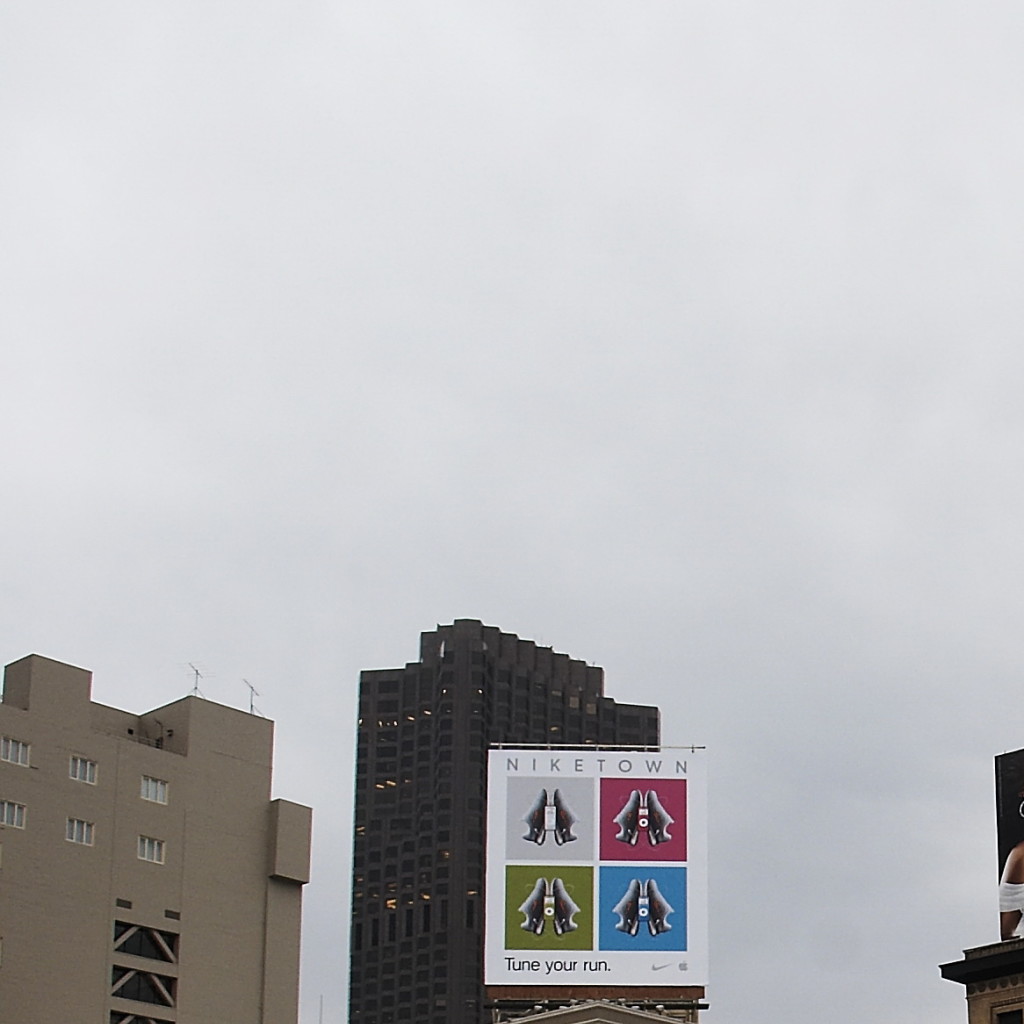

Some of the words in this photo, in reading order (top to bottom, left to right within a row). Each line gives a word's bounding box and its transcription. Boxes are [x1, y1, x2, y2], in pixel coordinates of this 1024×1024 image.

[506, 758, 688, 774] NIKETOWN
[505, 957, 541, 972] Tune
[545, 960, 578, 976] your
[583, 958, 611, 972] run.
